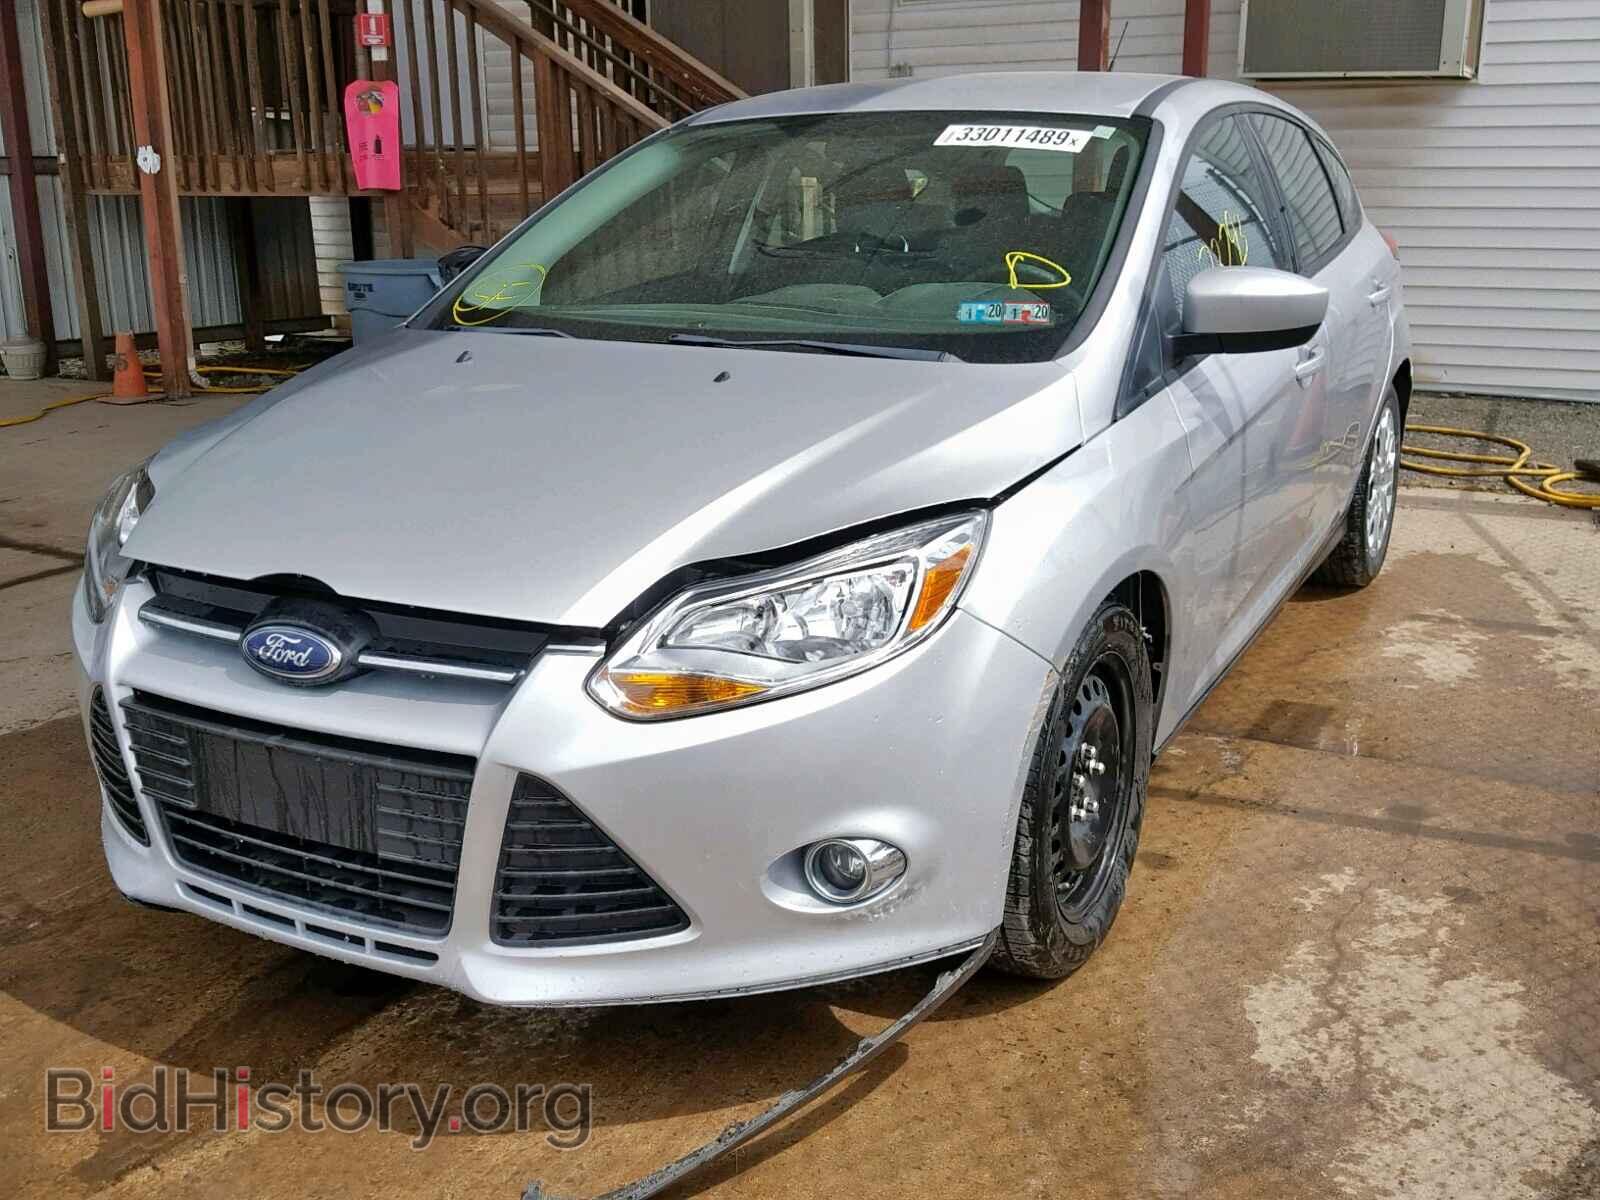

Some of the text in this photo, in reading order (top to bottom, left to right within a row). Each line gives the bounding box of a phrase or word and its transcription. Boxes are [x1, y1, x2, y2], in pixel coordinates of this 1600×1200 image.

[956, 127, 1071, 146] 33011489
[988, 304, 1001, 318] 20
[1034, 305, 1049, 319] 20
[258, 633, 314, 667] Ford
